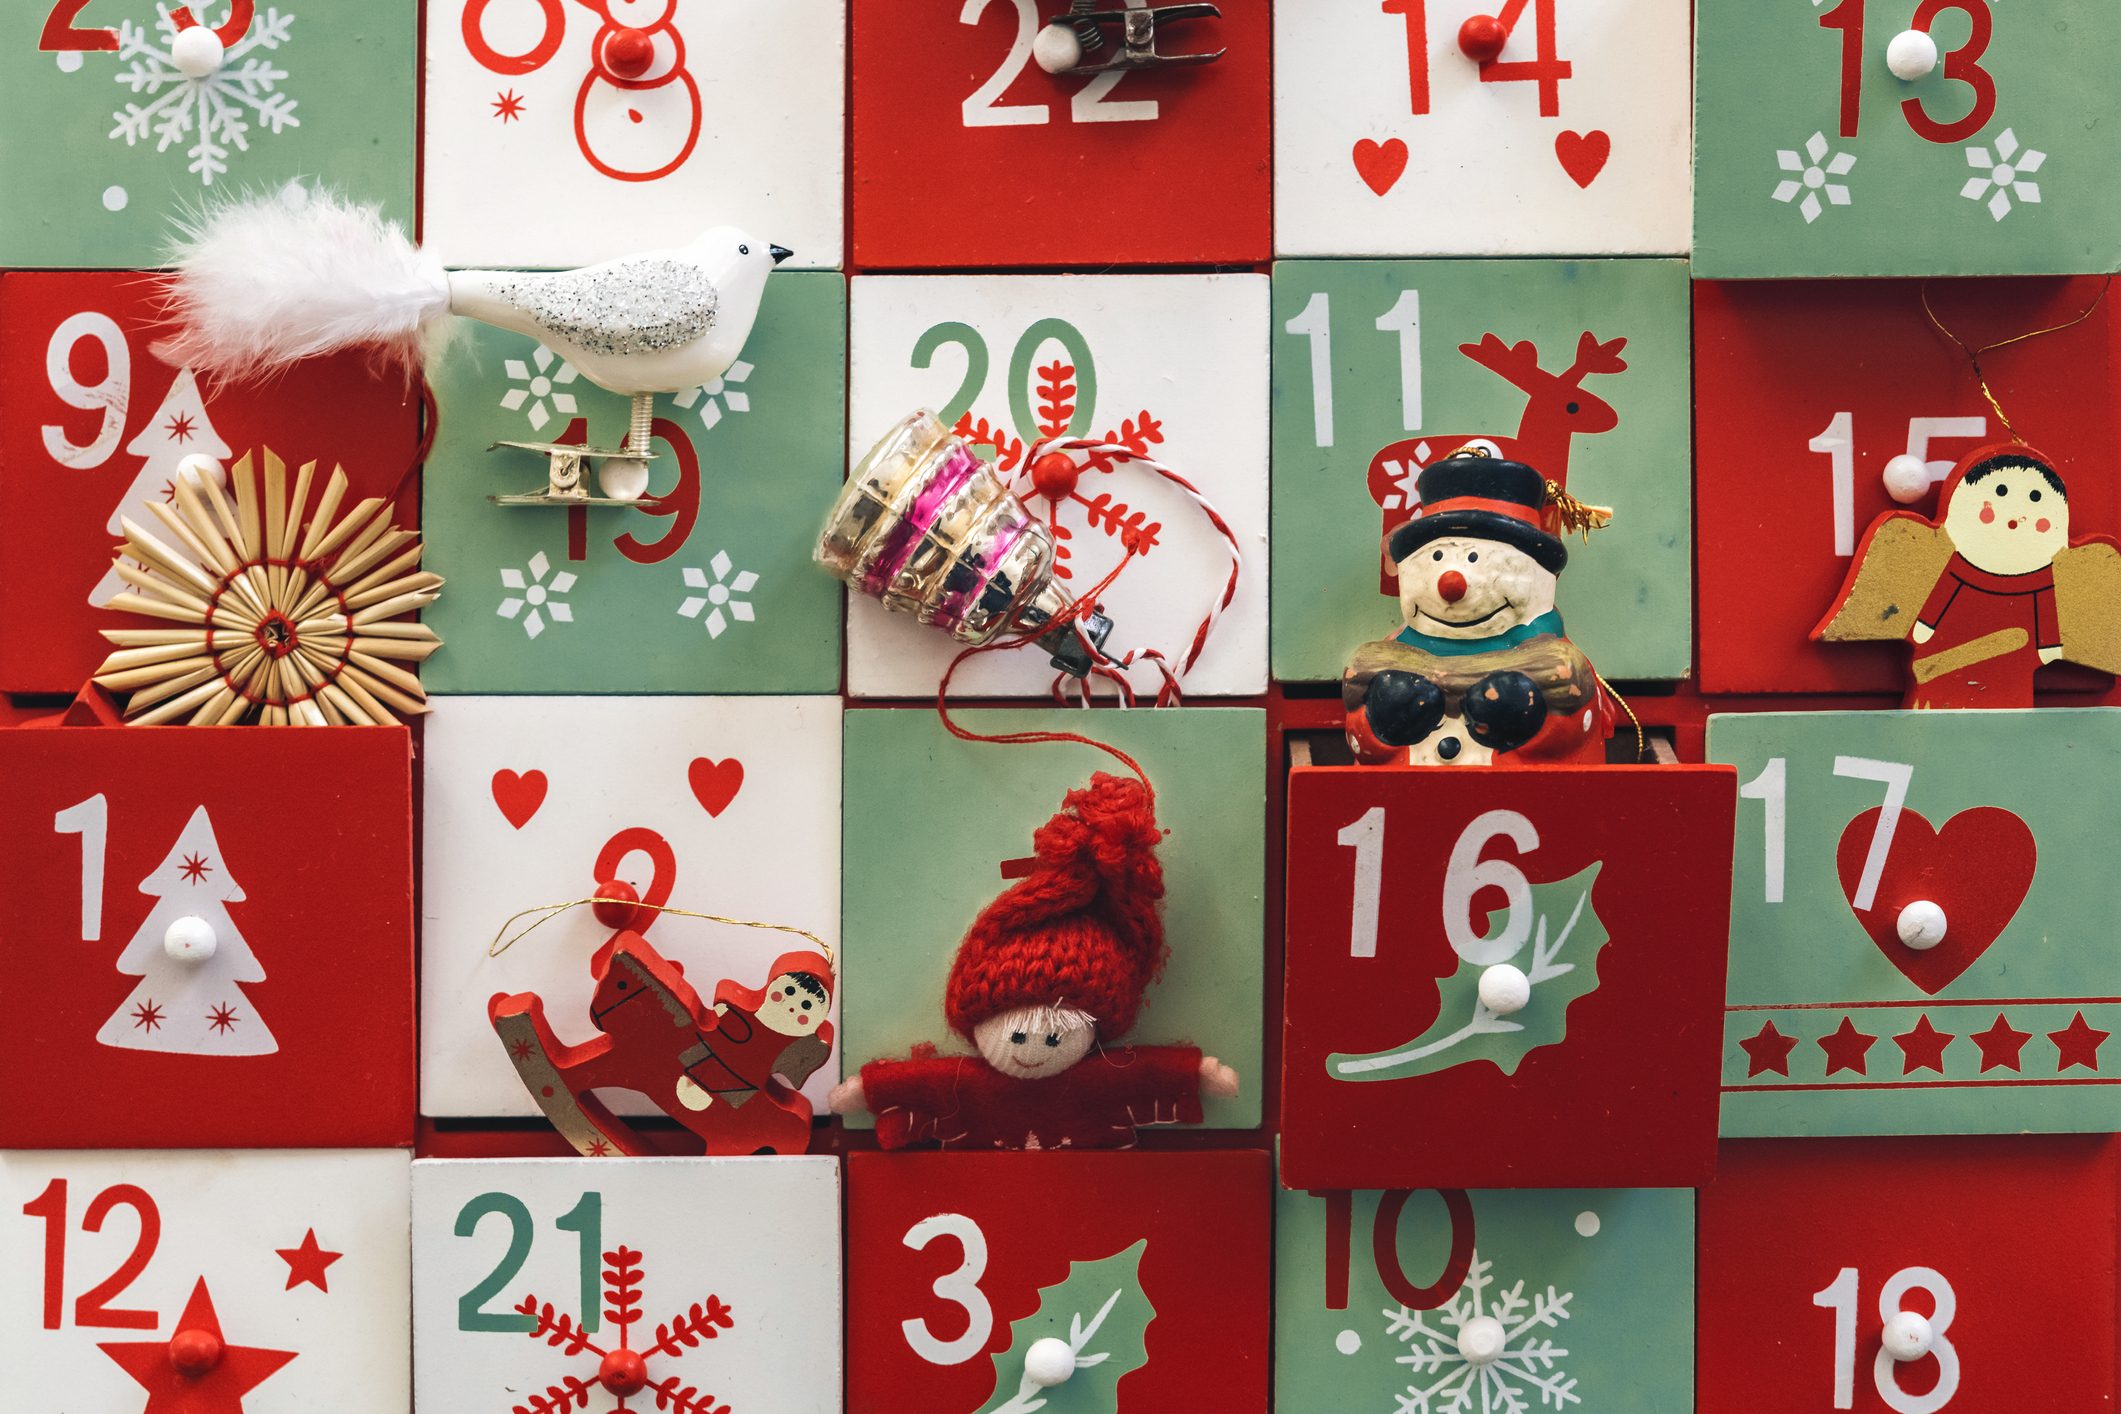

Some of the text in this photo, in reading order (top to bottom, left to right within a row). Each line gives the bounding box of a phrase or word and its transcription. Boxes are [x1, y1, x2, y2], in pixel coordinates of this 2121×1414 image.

[1382, 0, 1572, 117] 14
[1819, 0, 1997, 144] 13
[41, 311, 131, 469] 9
[910, 317, 1097, 463] 20
[1285, 289, 1422, 447] 11
[544, 417, 701, 564] 19
[55, 793, 107, 941] 1
[1337, 806, 1541, 966] 16
[1740, 755, 1914, 912] 17
[23, 1178, 161, 1331] 12
[454, 1191, 602, 1334] 21
[902, 1212, 993, 1365] 3
[1308, 1187, 1475, 1311] 10
[1813, 1266, 1960, 1414] 18
